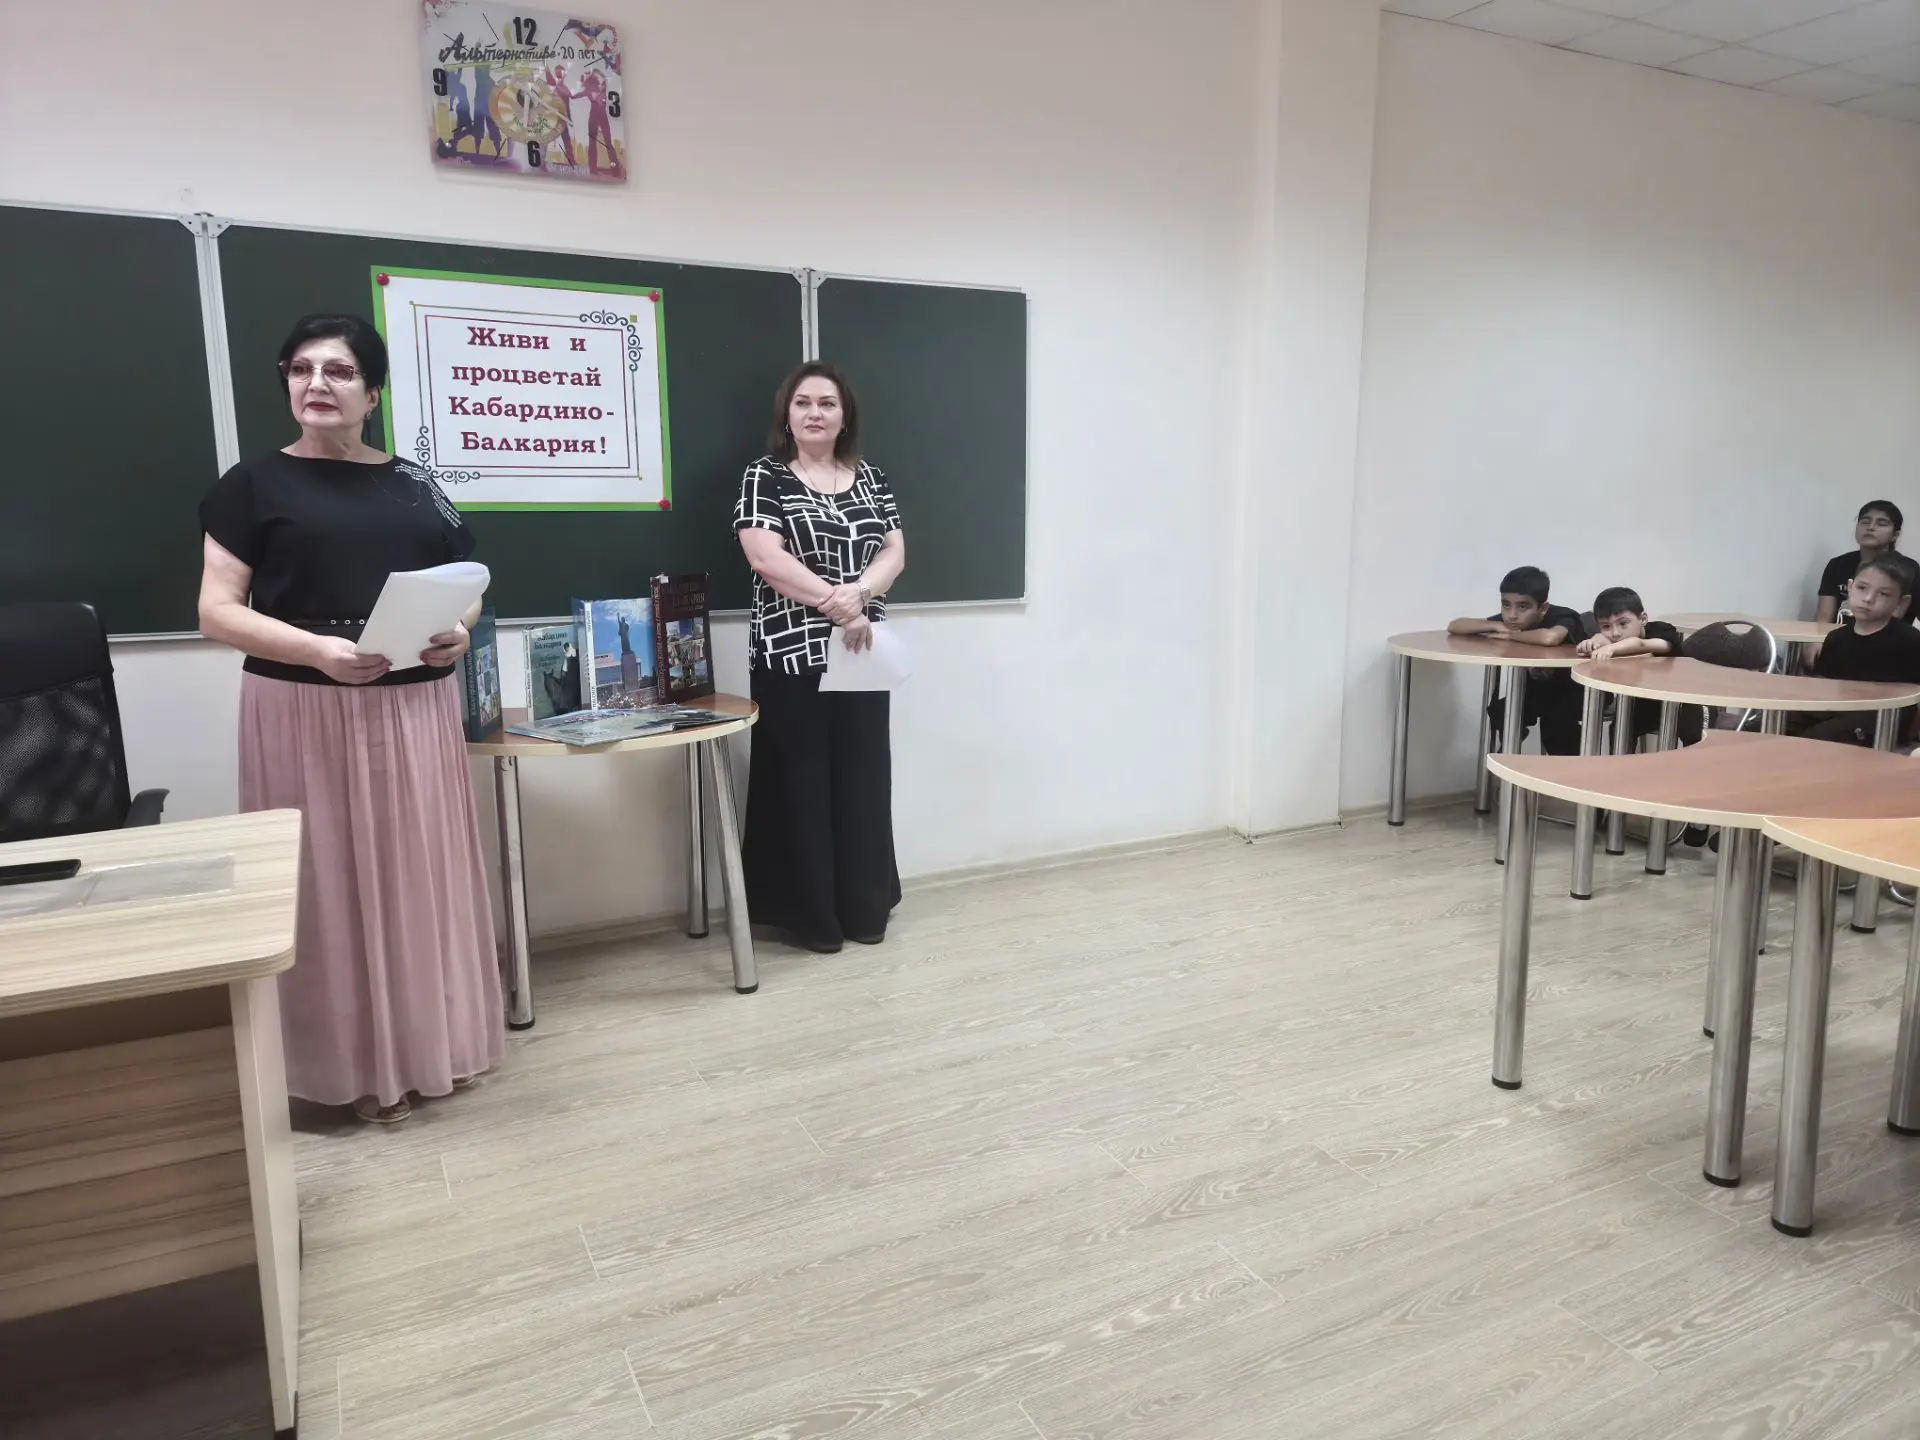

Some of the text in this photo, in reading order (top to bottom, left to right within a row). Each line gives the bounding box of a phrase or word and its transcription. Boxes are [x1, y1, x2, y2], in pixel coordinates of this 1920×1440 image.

[512, 16, 538, 46] 12
[432, 68, 448, 96] 9
[608, 91, 621, 117] 3
[527, 140, 541, 167] 6
[467, 326, 587, 352] Живи и
[451, 365, 602, 387] процветай
[448, 396, 615, 422] Кабардино-
[461, 431, 608, 457] Балкария!
